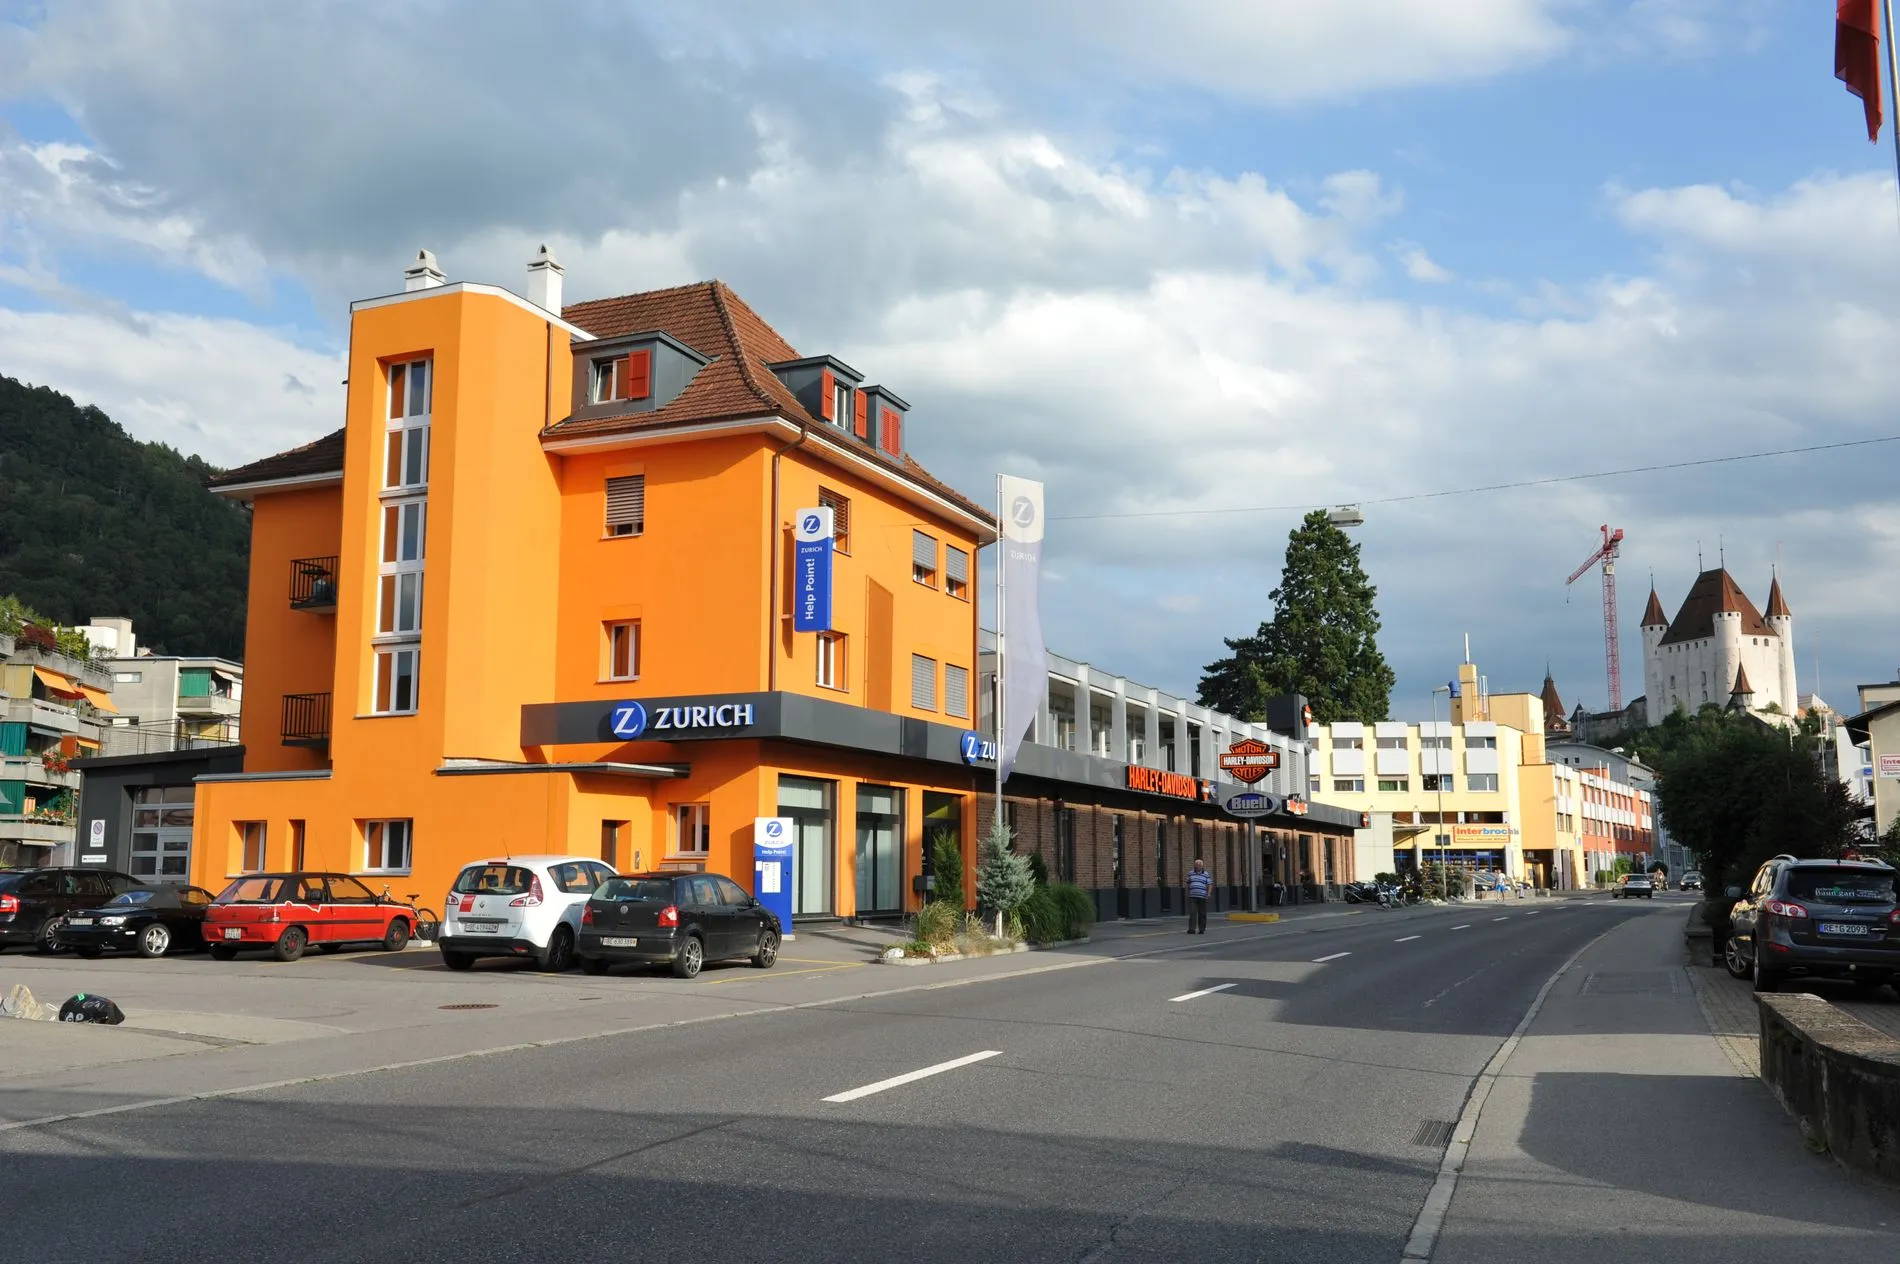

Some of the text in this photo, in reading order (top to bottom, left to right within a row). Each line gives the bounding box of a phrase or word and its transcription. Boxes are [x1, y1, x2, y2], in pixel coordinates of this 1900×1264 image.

[801, 546, 823, 554] ZURICH
[805, 558, 816, 620] Help Point!
[654, 703, 754, 729] ZURICH
[1235, 743, 1262, 754] MOTOR
[1223, 755, 1274, 766] HARLEY-DAVIDSON
[1235, 767, 1263, 778] CYCLES
[1129, 764, 1197, 799] HARLEY-DAVIDSON
[1231, 796, 1268, 809] Buell
